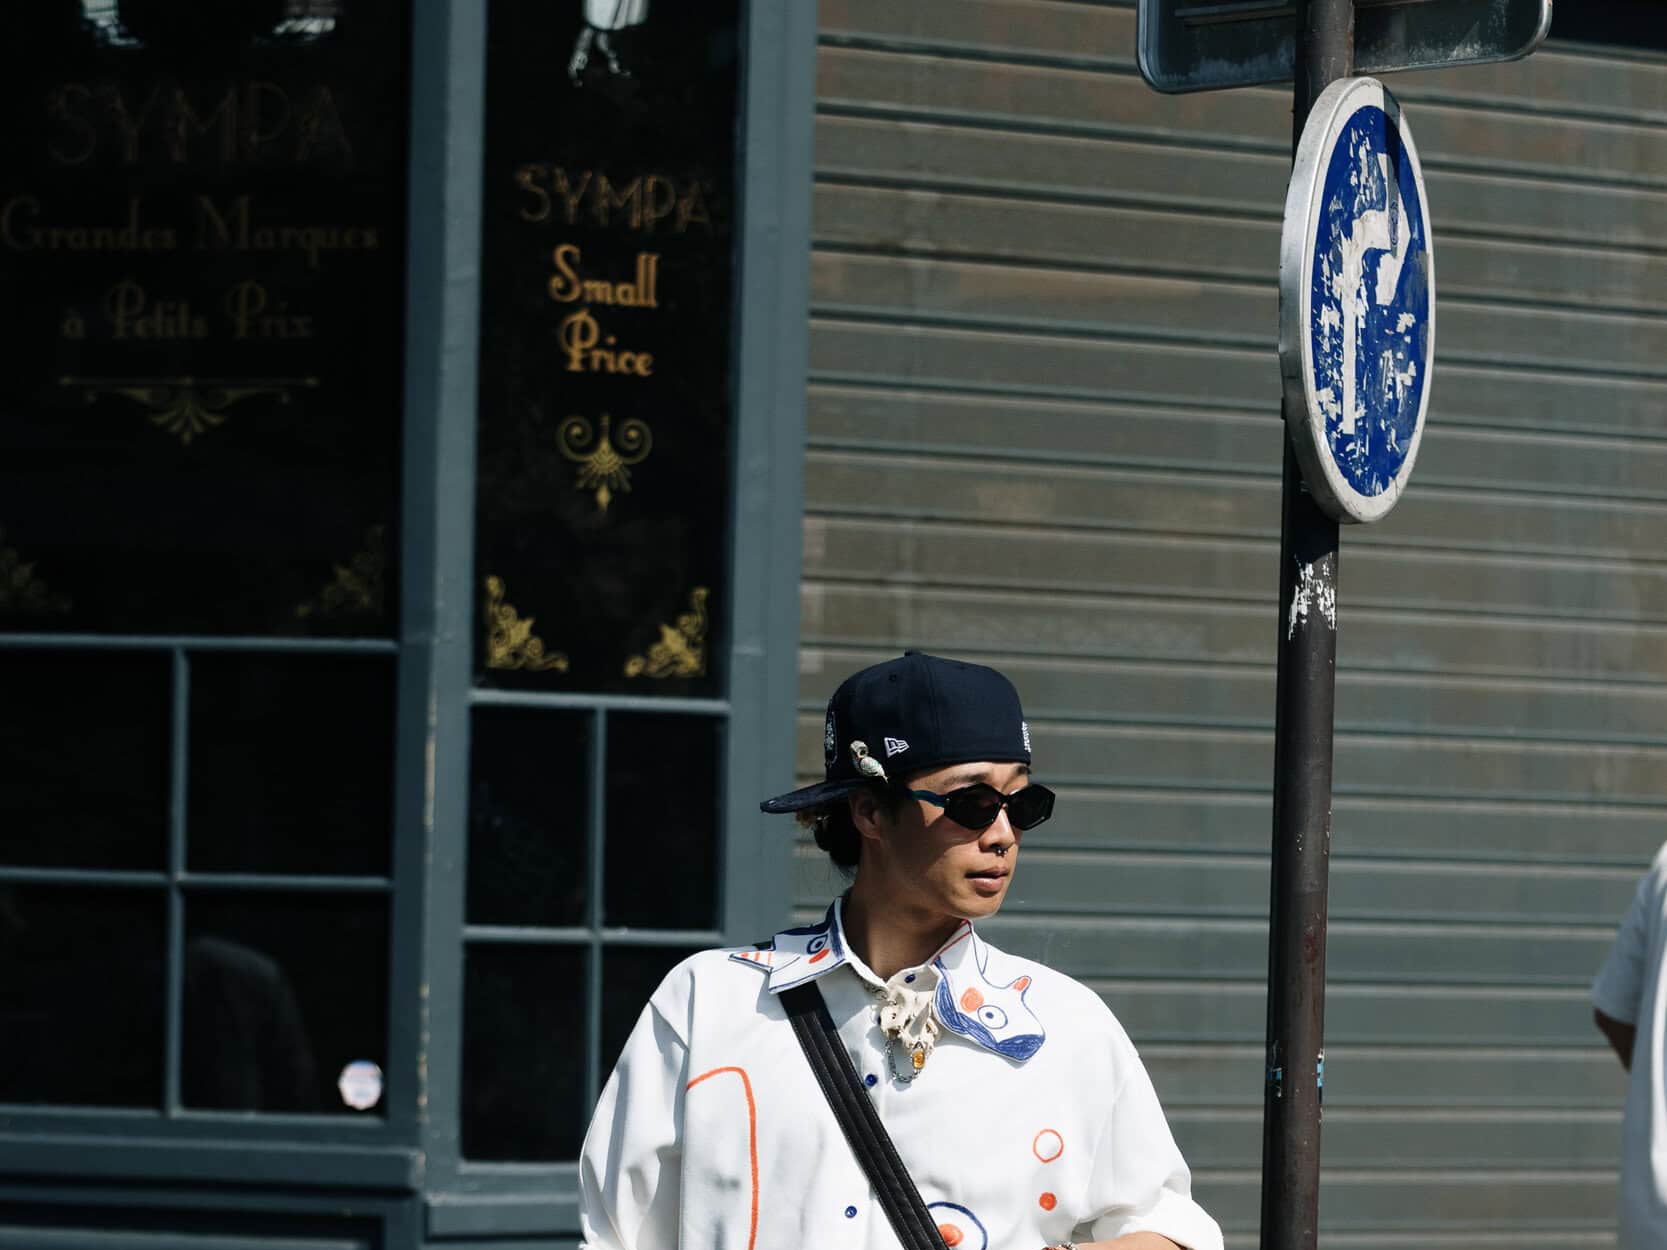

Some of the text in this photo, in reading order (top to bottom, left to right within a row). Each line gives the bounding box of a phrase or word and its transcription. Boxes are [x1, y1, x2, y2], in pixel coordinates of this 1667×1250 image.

[48, 79, 354, 167] SYMPA
[0, 193, 381, 269] Grandes Marques
[513, 161, 715, 236] SYMPA
[105, 276, 209, 340] Petits
[223, 277, 313, 340] Prix
[547, 242, 661, 309] Small
[558, 308, 656, 378] Price
